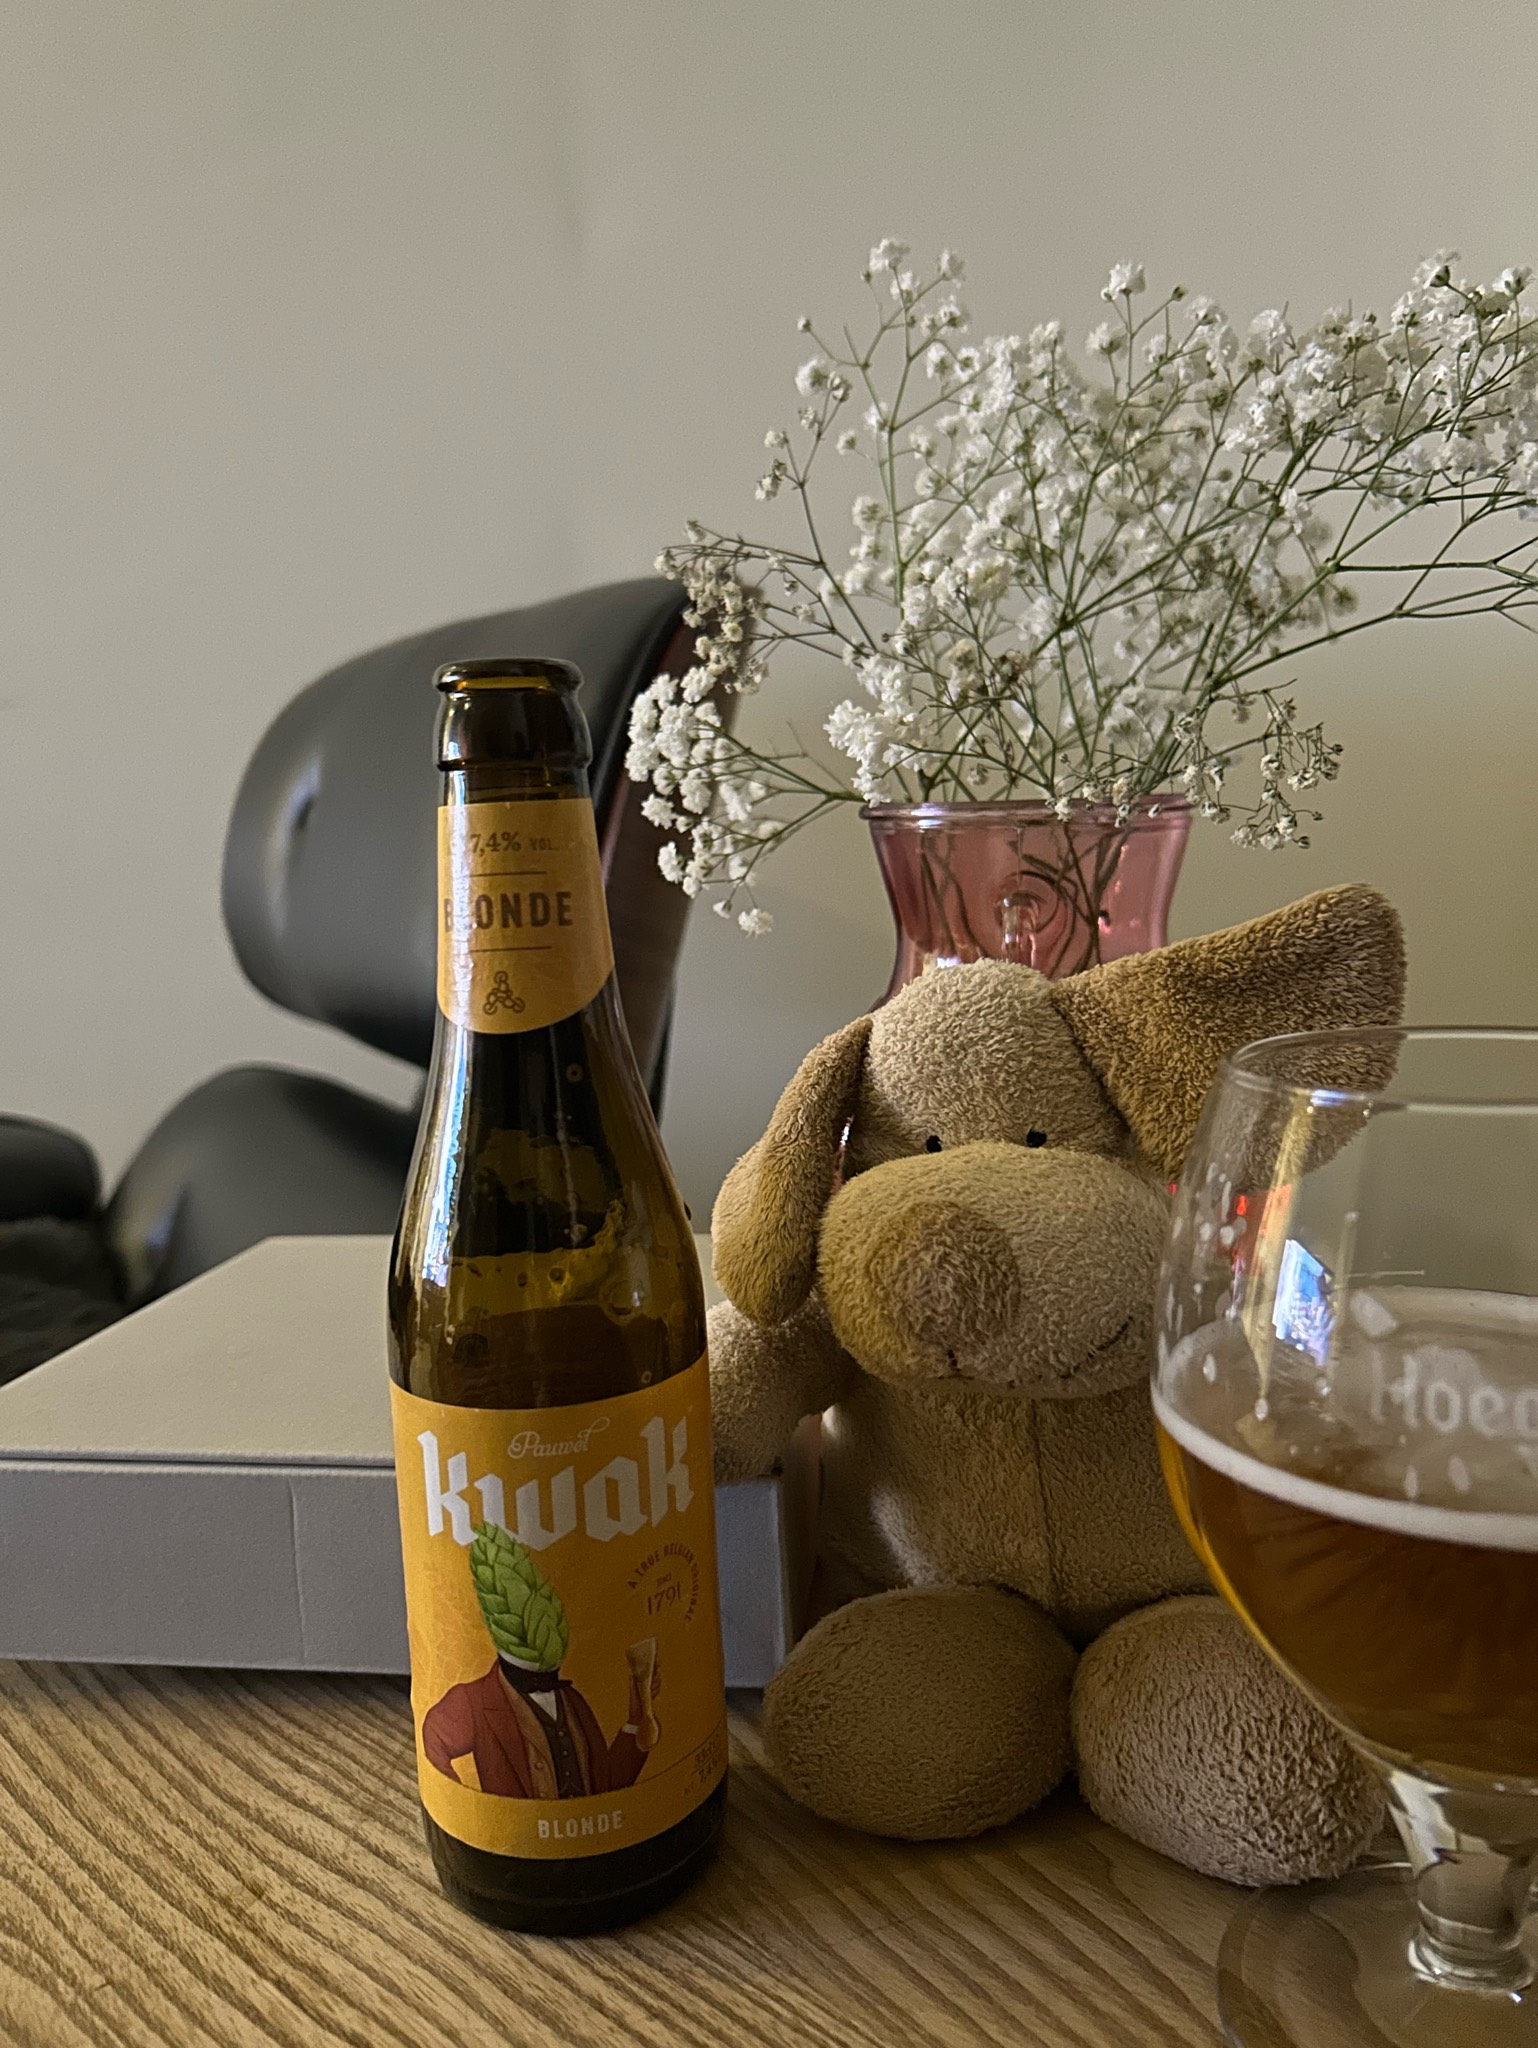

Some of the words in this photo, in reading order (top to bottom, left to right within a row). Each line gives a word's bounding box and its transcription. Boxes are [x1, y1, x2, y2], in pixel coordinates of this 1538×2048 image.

[470, 831, 522, 857] 7,4%
[443, 890, 574, 933] BONDE
[507, 1416, 611, 1460] Pauwel
[417, 1415, 695, 1552] kwak
[627, 1581, 639, 1590] A
[634, 1549, 661, 1577] TRUE
[663, 1542, 695, 1565] BELGIAN
[647, 1581, 681, 1616] 1791
[537, 1809, 624, 1839] BLONDE
